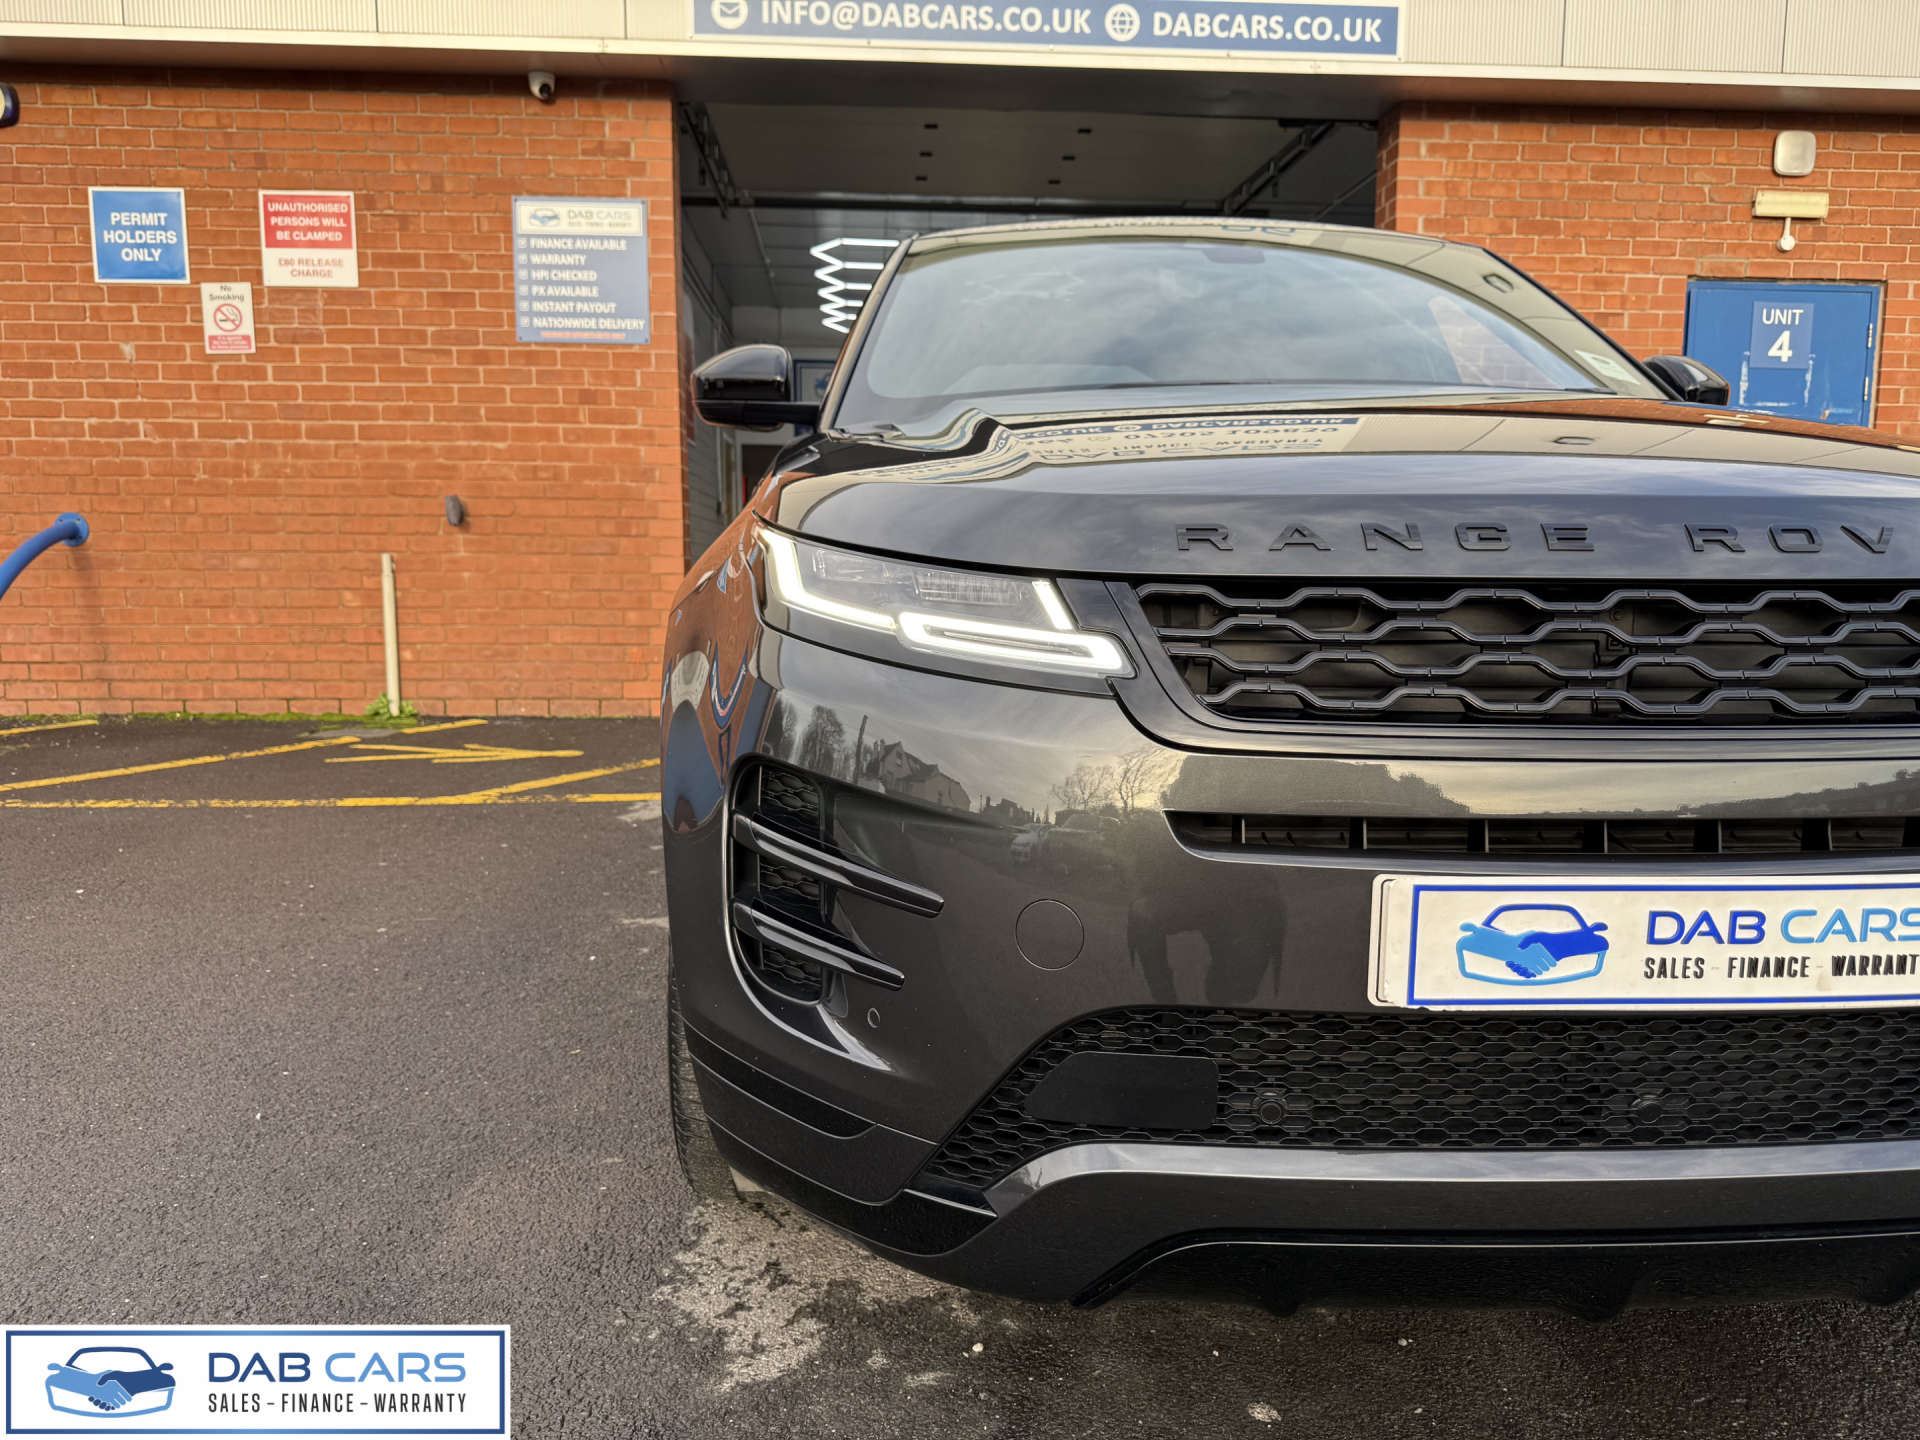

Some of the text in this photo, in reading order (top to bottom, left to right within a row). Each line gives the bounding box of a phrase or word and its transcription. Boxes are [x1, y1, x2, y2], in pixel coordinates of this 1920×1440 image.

[761, 0, 1092, 34] INFO@DABCARS.CO.UK
[1152, 11, 1382, 42] DABCARS.CO.UK
[267, 202, 348, 213] UNAUTHORISED
[110, 212, 168, 226] PERMIT
[270, 216, 347, 228] PERSONS WILL
[103, 229, 178, 244] HOLDERS
[276, 231, 343, 242] BE CLAMPED
[530, 238, 627, 251] FINANCE AVAILABLE
[121, 247, 162, 262] ONLY
[531, 253, 587, 265] WARRANTY
[297, 257, 344, 268] RELEASE
[290, 268, 334, 279] CHARGE
[532, 269, 597, 281] HPI CHECKED
[208, 293, 245, 303] Smoking
[547, 285, 599, 298] AVAILABLE
[533, 301, 616, 313] INSTANT PAYOUT
[1762, 308, 1805, 325] UNIT
[534, 316, 645, 331] NATIONWIDE DELIVERY
[1767, 330, 1793, 363] 4
[1175, 522, 1596, 552] RANGE
[1646, 907, 1920, 945] DAB CARS
[1643, 957, 1705, 979] SALES
[1727, 956, 1811, 978] FINANCE
